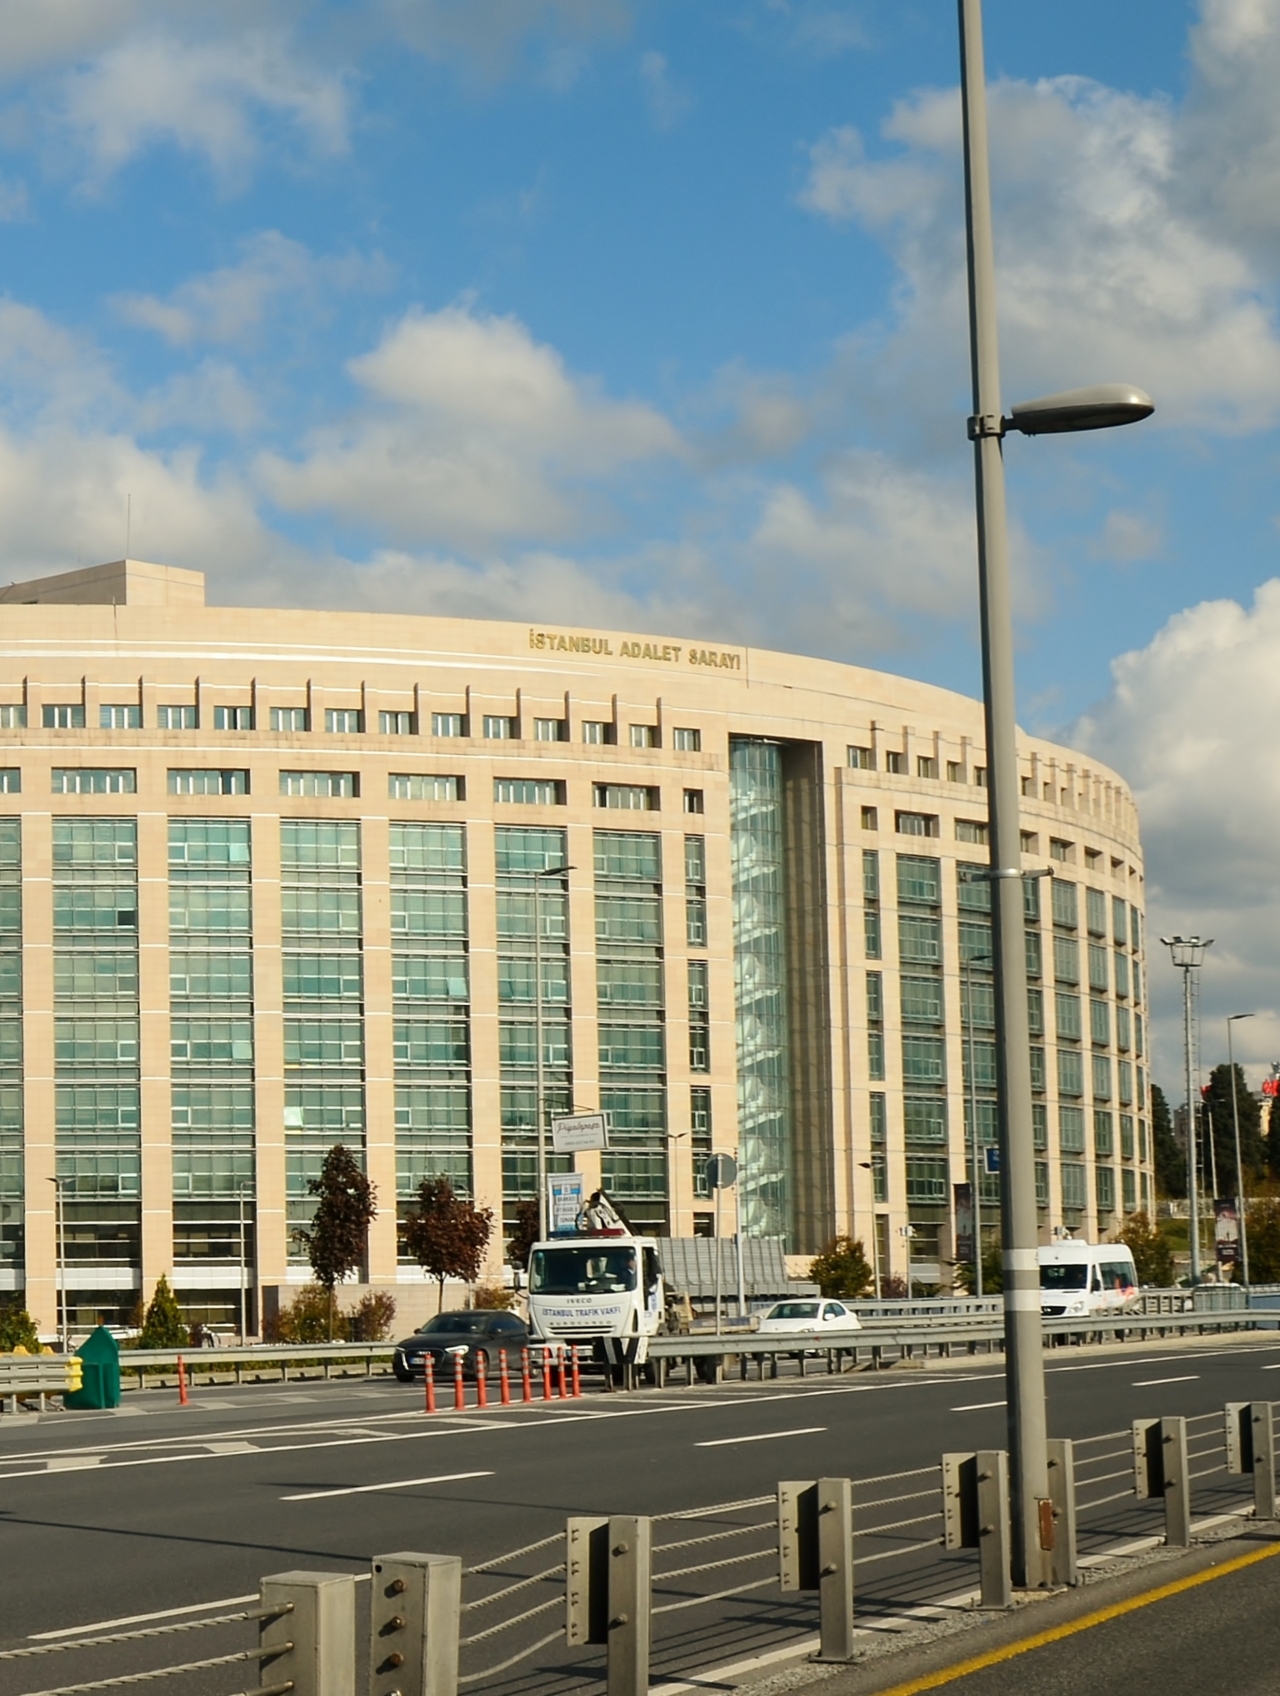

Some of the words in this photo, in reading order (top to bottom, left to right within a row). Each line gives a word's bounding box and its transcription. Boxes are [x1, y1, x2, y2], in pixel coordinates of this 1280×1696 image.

[529, 628, 613, 656] İSTANBUL
[619, 641, 682, 662] ADALET
[688, 649, 741, 670] SARAYI
[575, 1308, 599, 1316] TRAFİK
[599, 1306, 621, 1316] VAKFI
